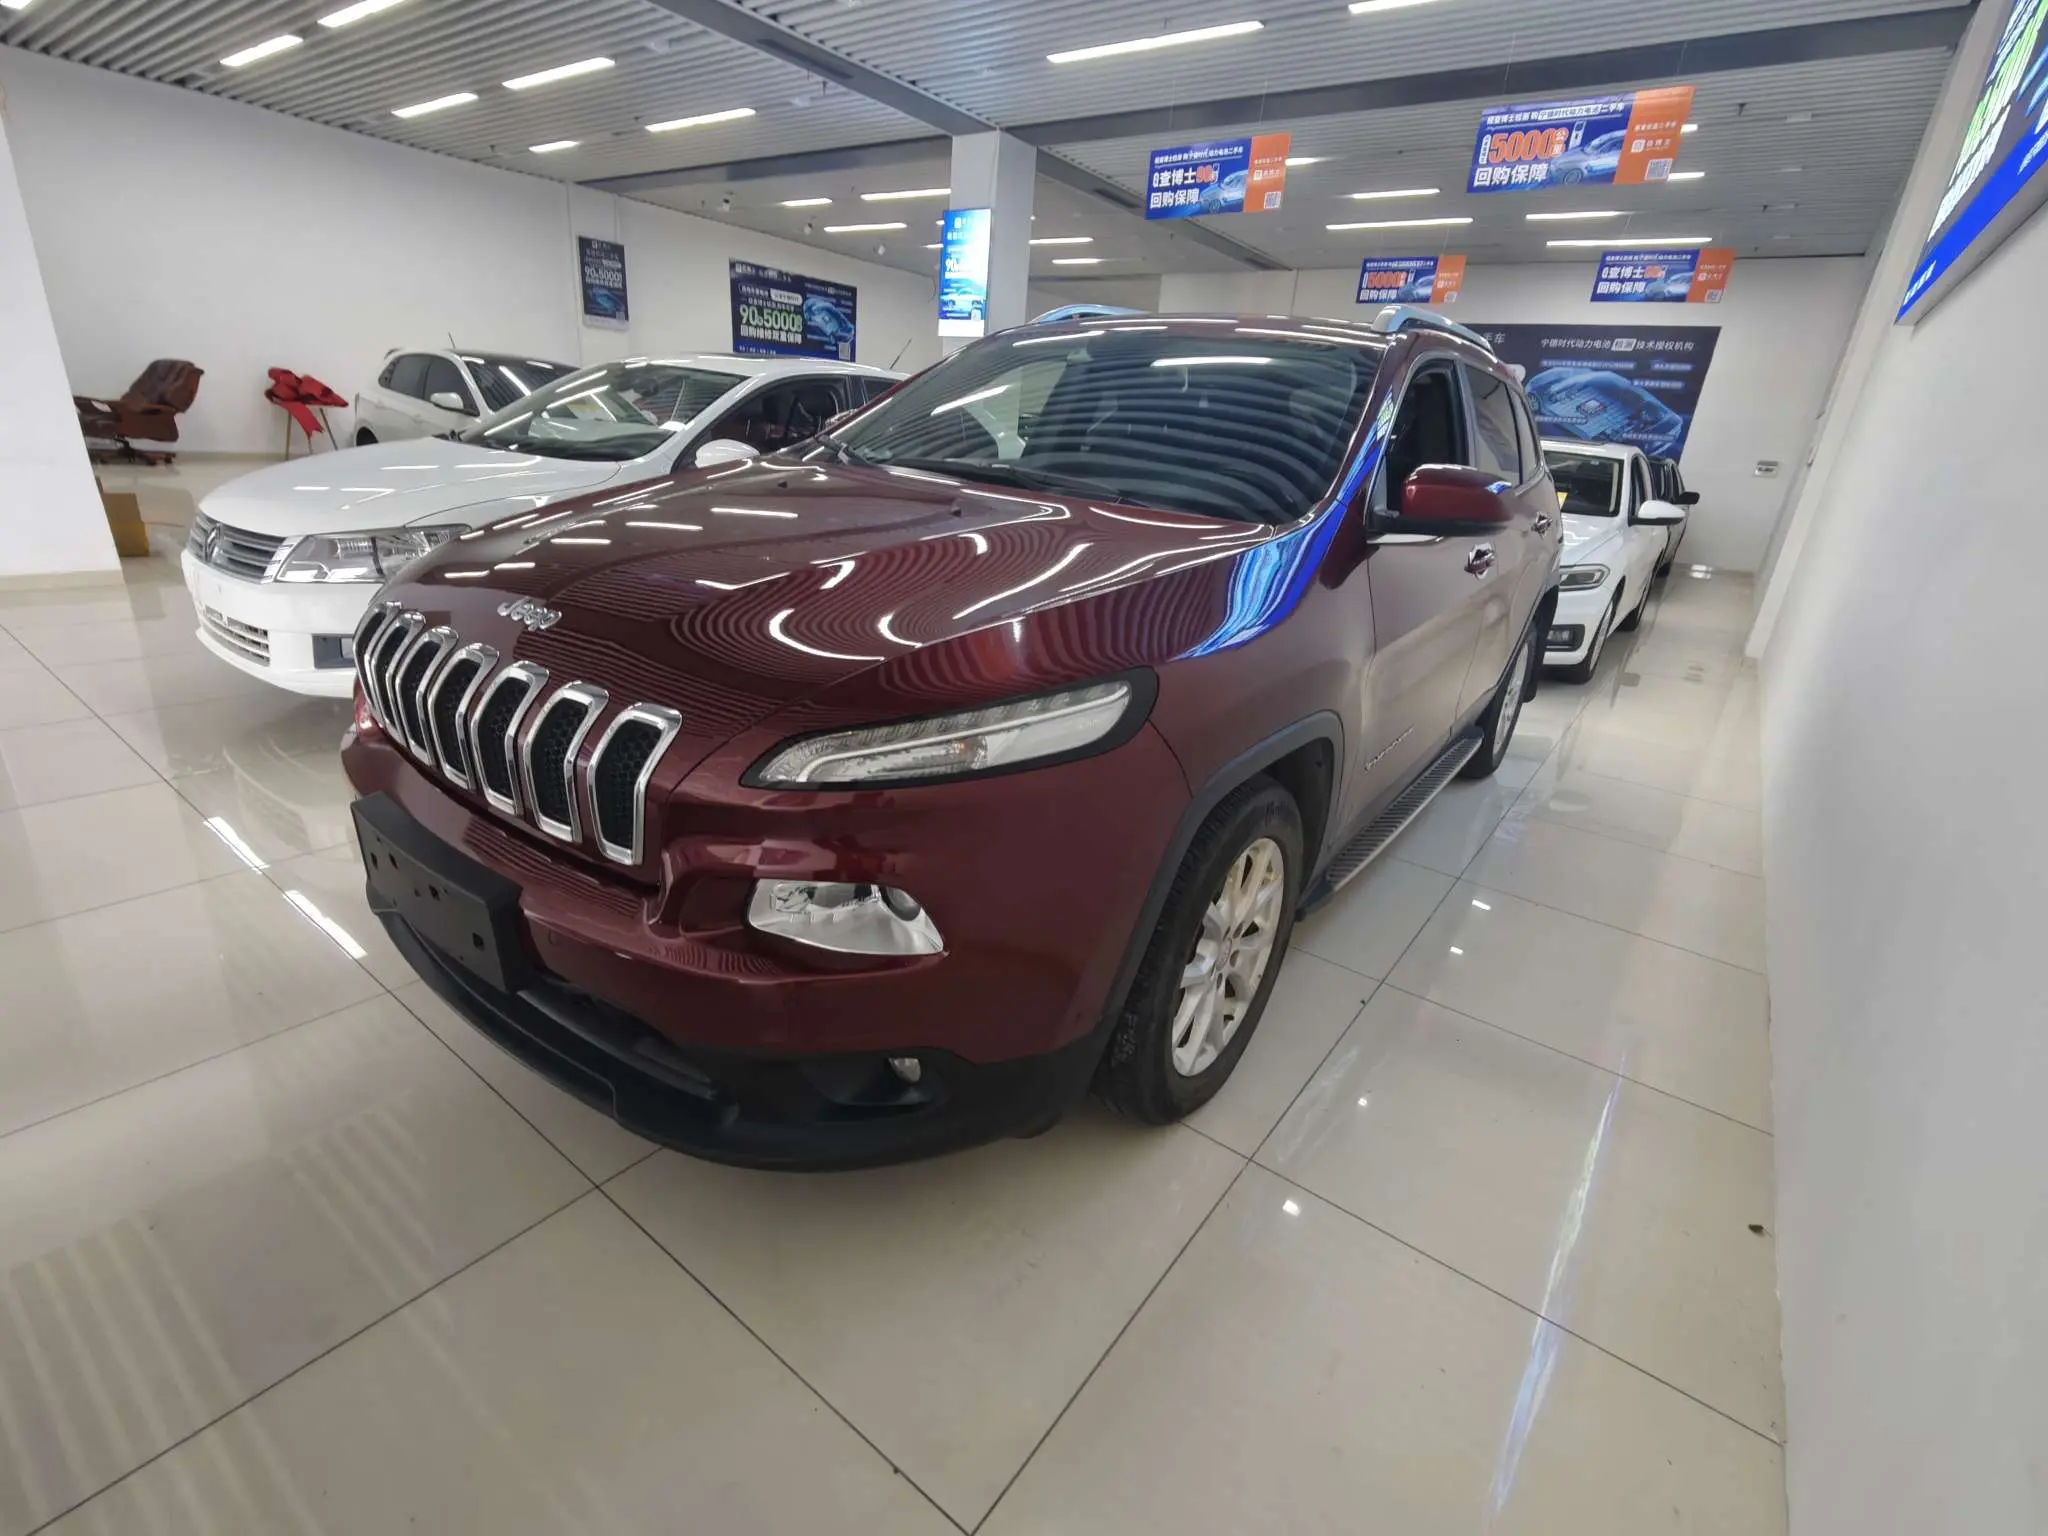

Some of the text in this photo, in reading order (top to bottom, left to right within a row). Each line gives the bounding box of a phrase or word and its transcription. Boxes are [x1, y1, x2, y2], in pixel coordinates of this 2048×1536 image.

[1473, 163, 1549, 188] 回购保障
[1150, 188, 1200, 209] 回购保障
[1596, 281, 1646, 294] 回购保障
